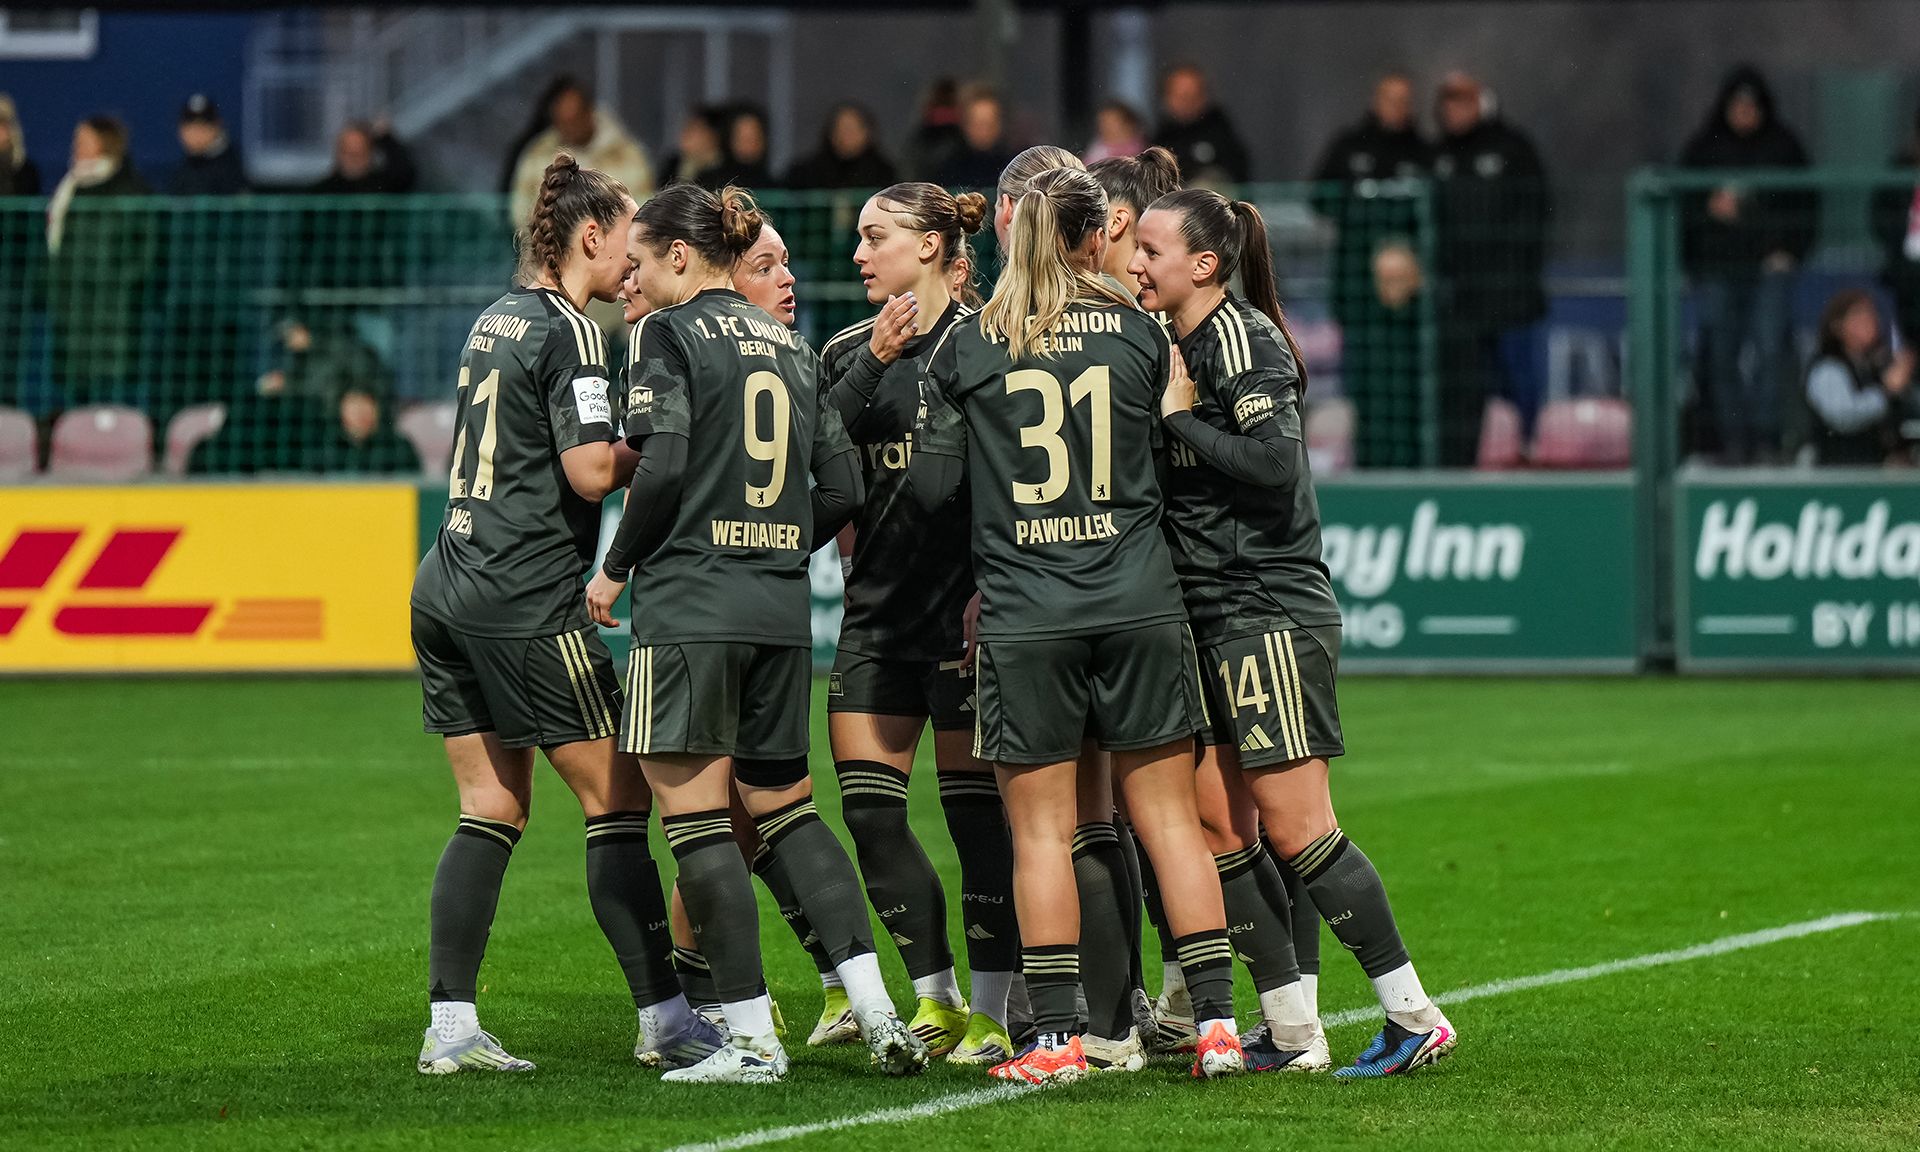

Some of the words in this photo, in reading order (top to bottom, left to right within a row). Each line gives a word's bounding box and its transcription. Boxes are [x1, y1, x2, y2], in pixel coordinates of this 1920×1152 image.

[482, 314, 532, 342] UNION
[696, 317, 717, 339] 1.
[715, 316, 744, 338] FC
[1036, 336, 1083, 351] ERLIN
[740, 340, 777, 360] BERLIN
[744, 370, 790, 508] 9
[1005, 365, 1112, 504] 31
[711, 519, 801, 550] WEIDAUER
[1015, 512, 1120, 545] PAWOLLEK
[1404, 499, 1526, 582] Inn
[1811, 602, 1875, 649] BY
[1218, 654, 1270, 719] 14
